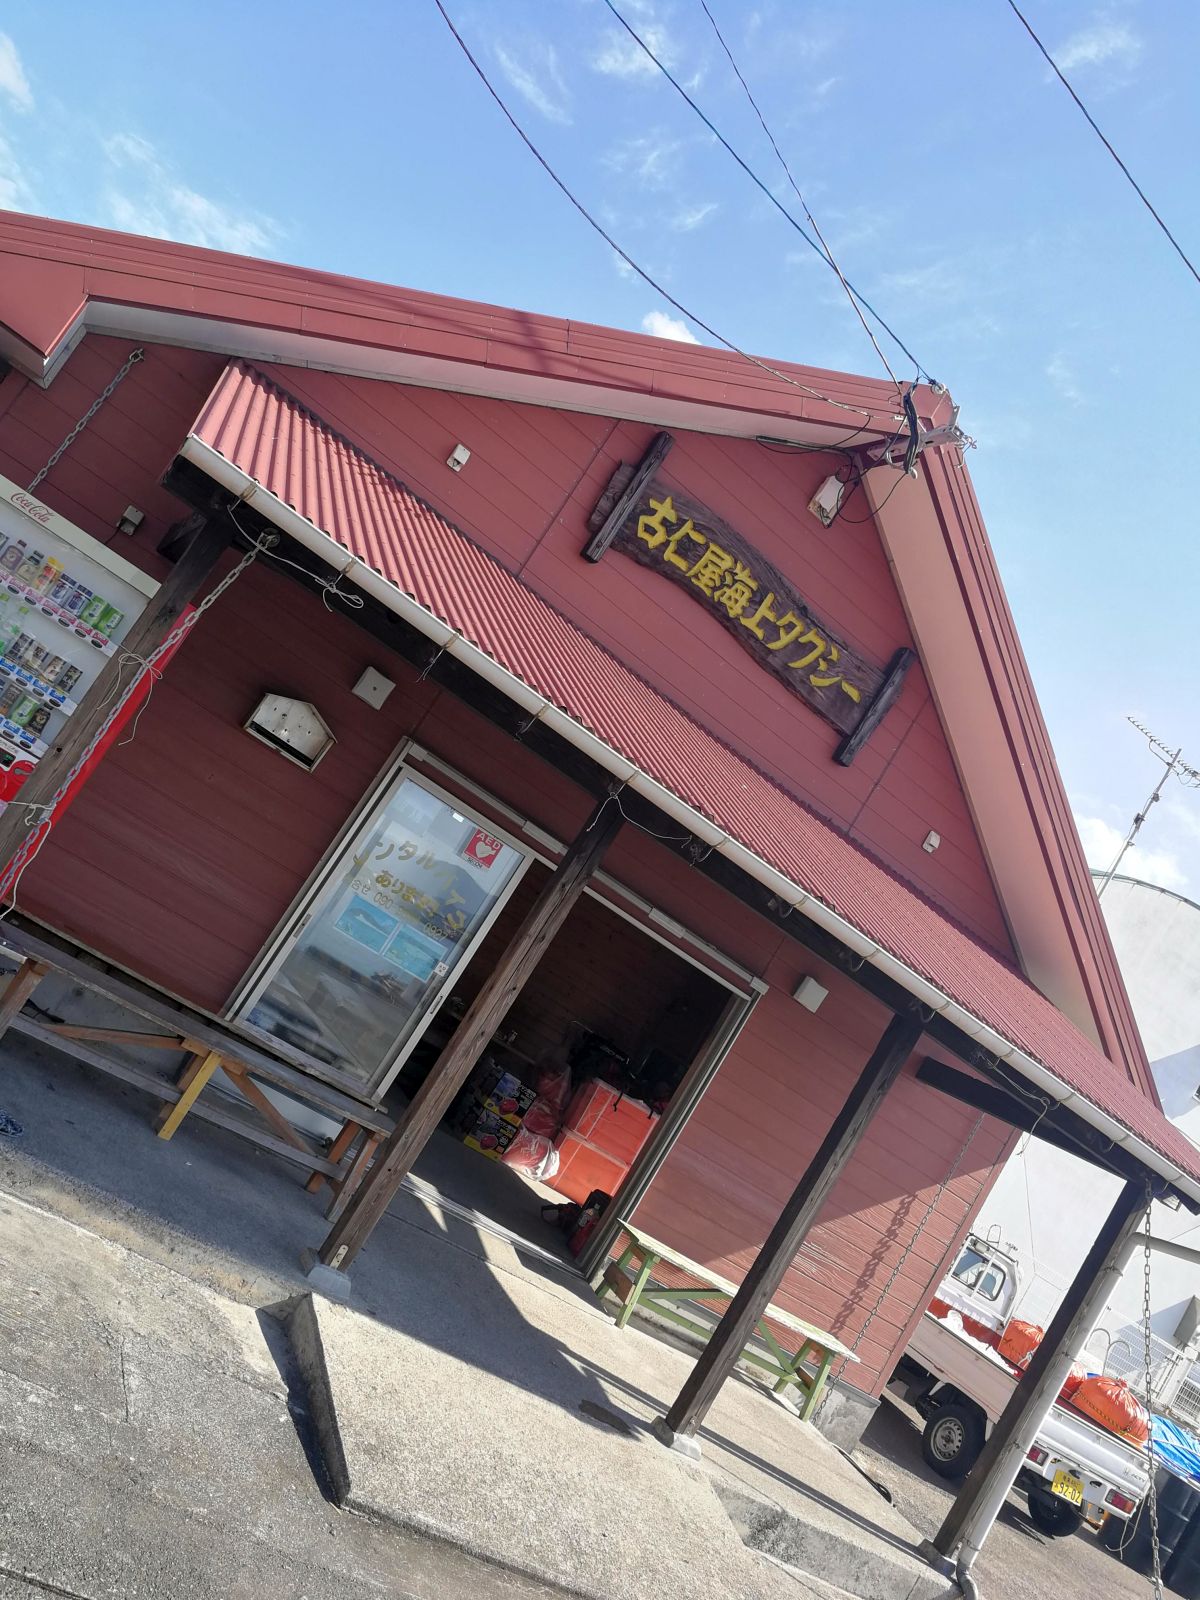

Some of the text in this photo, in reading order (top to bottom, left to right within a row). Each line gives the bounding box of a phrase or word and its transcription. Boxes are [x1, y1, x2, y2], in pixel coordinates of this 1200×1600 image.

[637, 496, 862, 703] 古仁屋海上タクシー
[476, 832, 501, 850] AED
